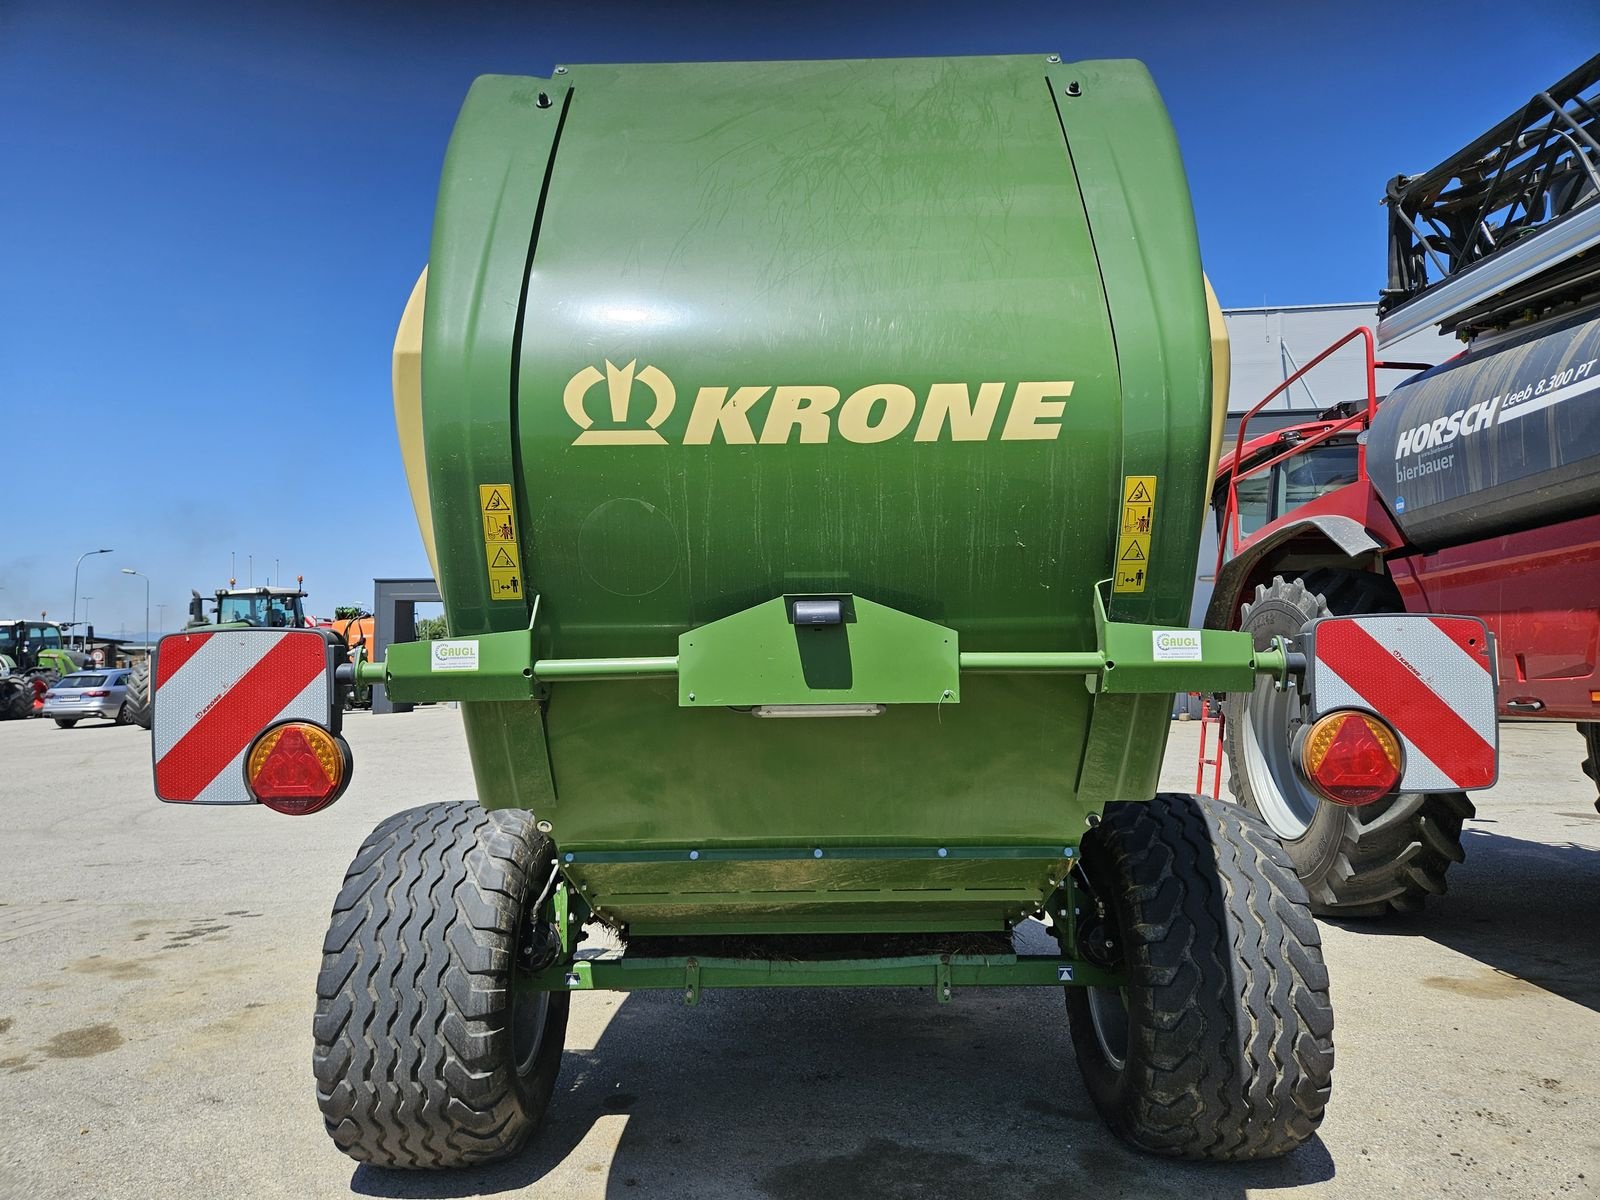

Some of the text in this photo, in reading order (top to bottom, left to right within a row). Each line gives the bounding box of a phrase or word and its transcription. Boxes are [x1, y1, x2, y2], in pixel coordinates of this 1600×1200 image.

[1502, 358, 1598, 408] Leeb 8.300 PT
[683, 380, 1075, 446] KRONE
[1395, 395, 1501, 461] HORSCH
[1395, 454, 1455, 484] bierbauer
[439, 647, 475, 657] GAUGL
[1161, 637, 1198, 647] GAUGL
[1399, 657, 1422, 677] KRONE
[202, 693, 222, 714] KRONE
